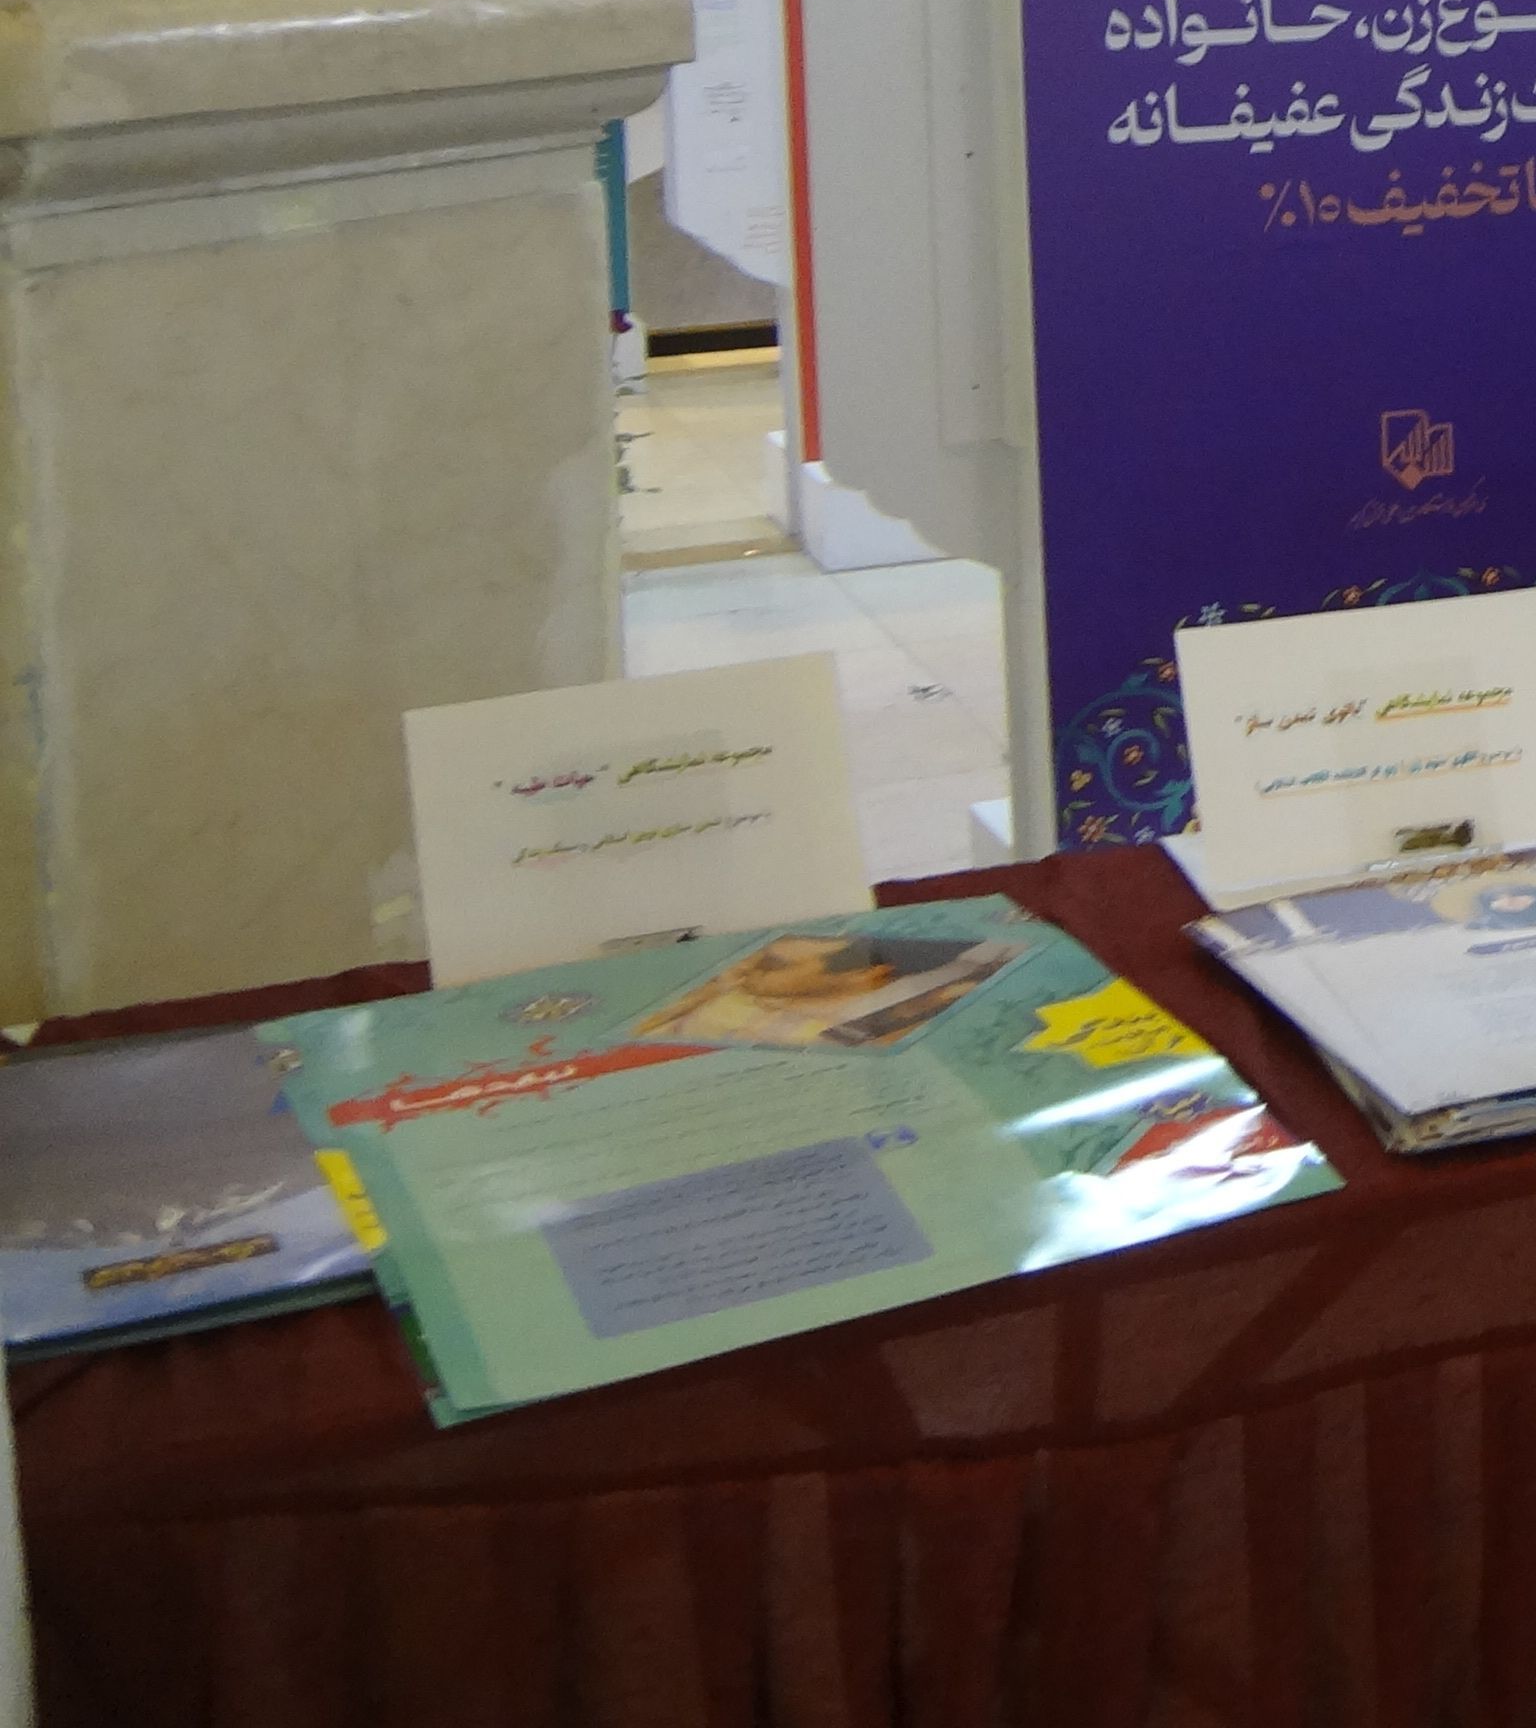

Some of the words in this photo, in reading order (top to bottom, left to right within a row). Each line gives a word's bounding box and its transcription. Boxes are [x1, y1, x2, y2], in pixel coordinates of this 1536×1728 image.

[1107, 83, 1350, 155] عفیفانه
[1350, 63, 1510, 154] زندگی
[1345, 164, 1519, 236] تخفیف
